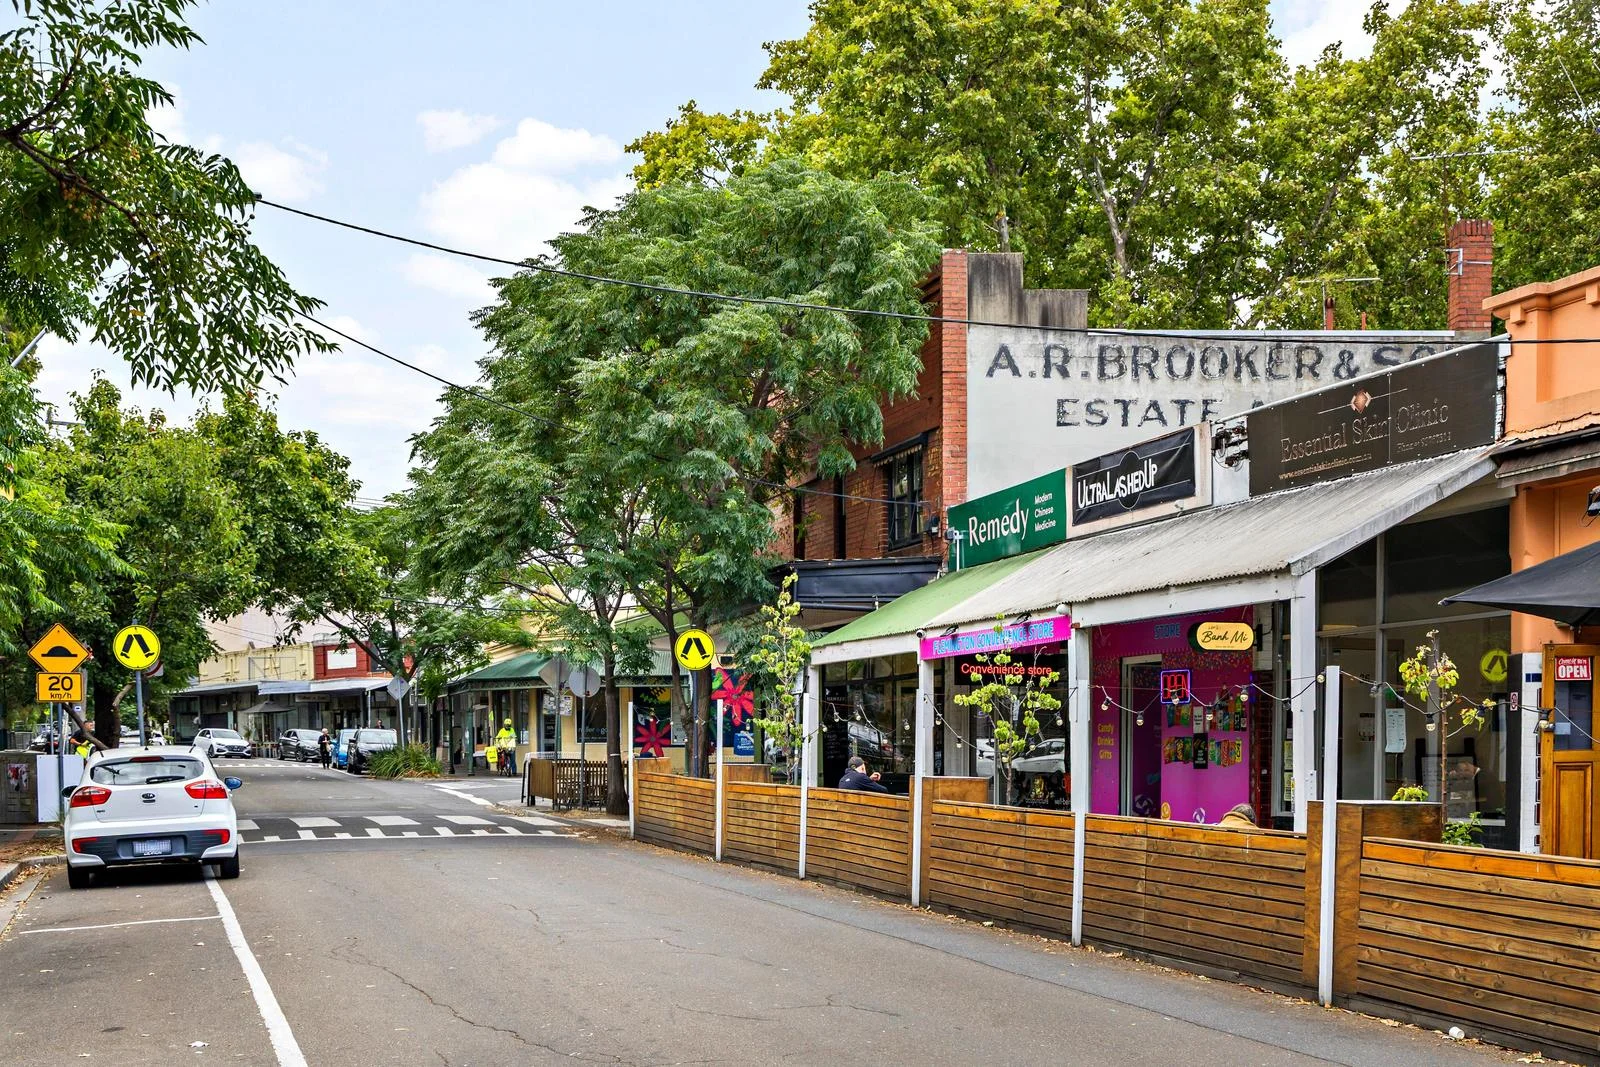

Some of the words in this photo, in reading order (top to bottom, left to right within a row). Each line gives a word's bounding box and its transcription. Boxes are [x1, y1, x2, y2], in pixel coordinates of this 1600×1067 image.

[1056, 398, 1222, 428] ESTATE
[1281, 423, 1347, 463] Essential
[1352, 414, 1390, 445] Skin
[1396, 398, 1449, 433] Clinic
[1034, 492, 1053, 505] Modern
[1034, 506, 1054, 518] Chinese
[968, 499, 1029, 547] Remedy
[1034, 519, 1056, 532] Medicine
[932, 636, 975, 655] FLEMINGTON
[977, 628, 1027, 648] CONVENIENCE
[1029, 621, 1054, 639] STORE
[1154, 623, 1180, 639] STORE
[1230, 630, 1248, 644] Mi
[961, 663, 1025, 675] Convenience
[1027, 665, 1052, 675] store
[1558, 665, 1588, 678] OPEN
[48, 676, 73, 691] 20
